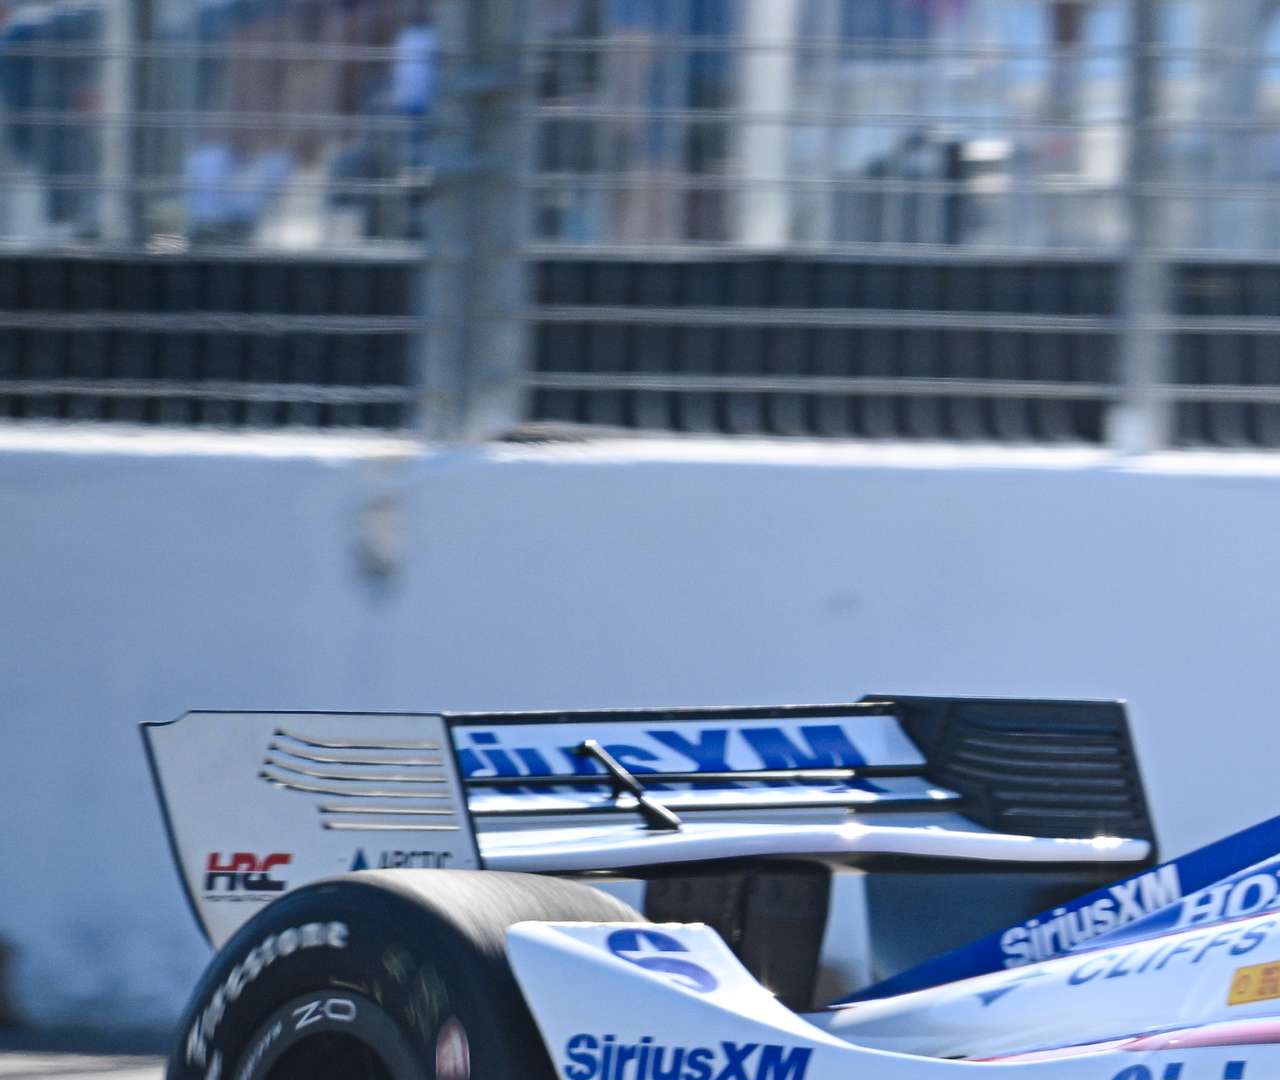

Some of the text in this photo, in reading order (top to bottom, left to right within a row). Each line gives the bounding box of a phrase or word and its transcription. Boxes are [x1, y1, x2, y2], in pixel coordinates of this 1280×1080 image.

[205, 853, 293, 892] HRC
[1001, 864, 1182, 969] SiriusXM
[1067, 919, 1277, 987] CLIFFS
